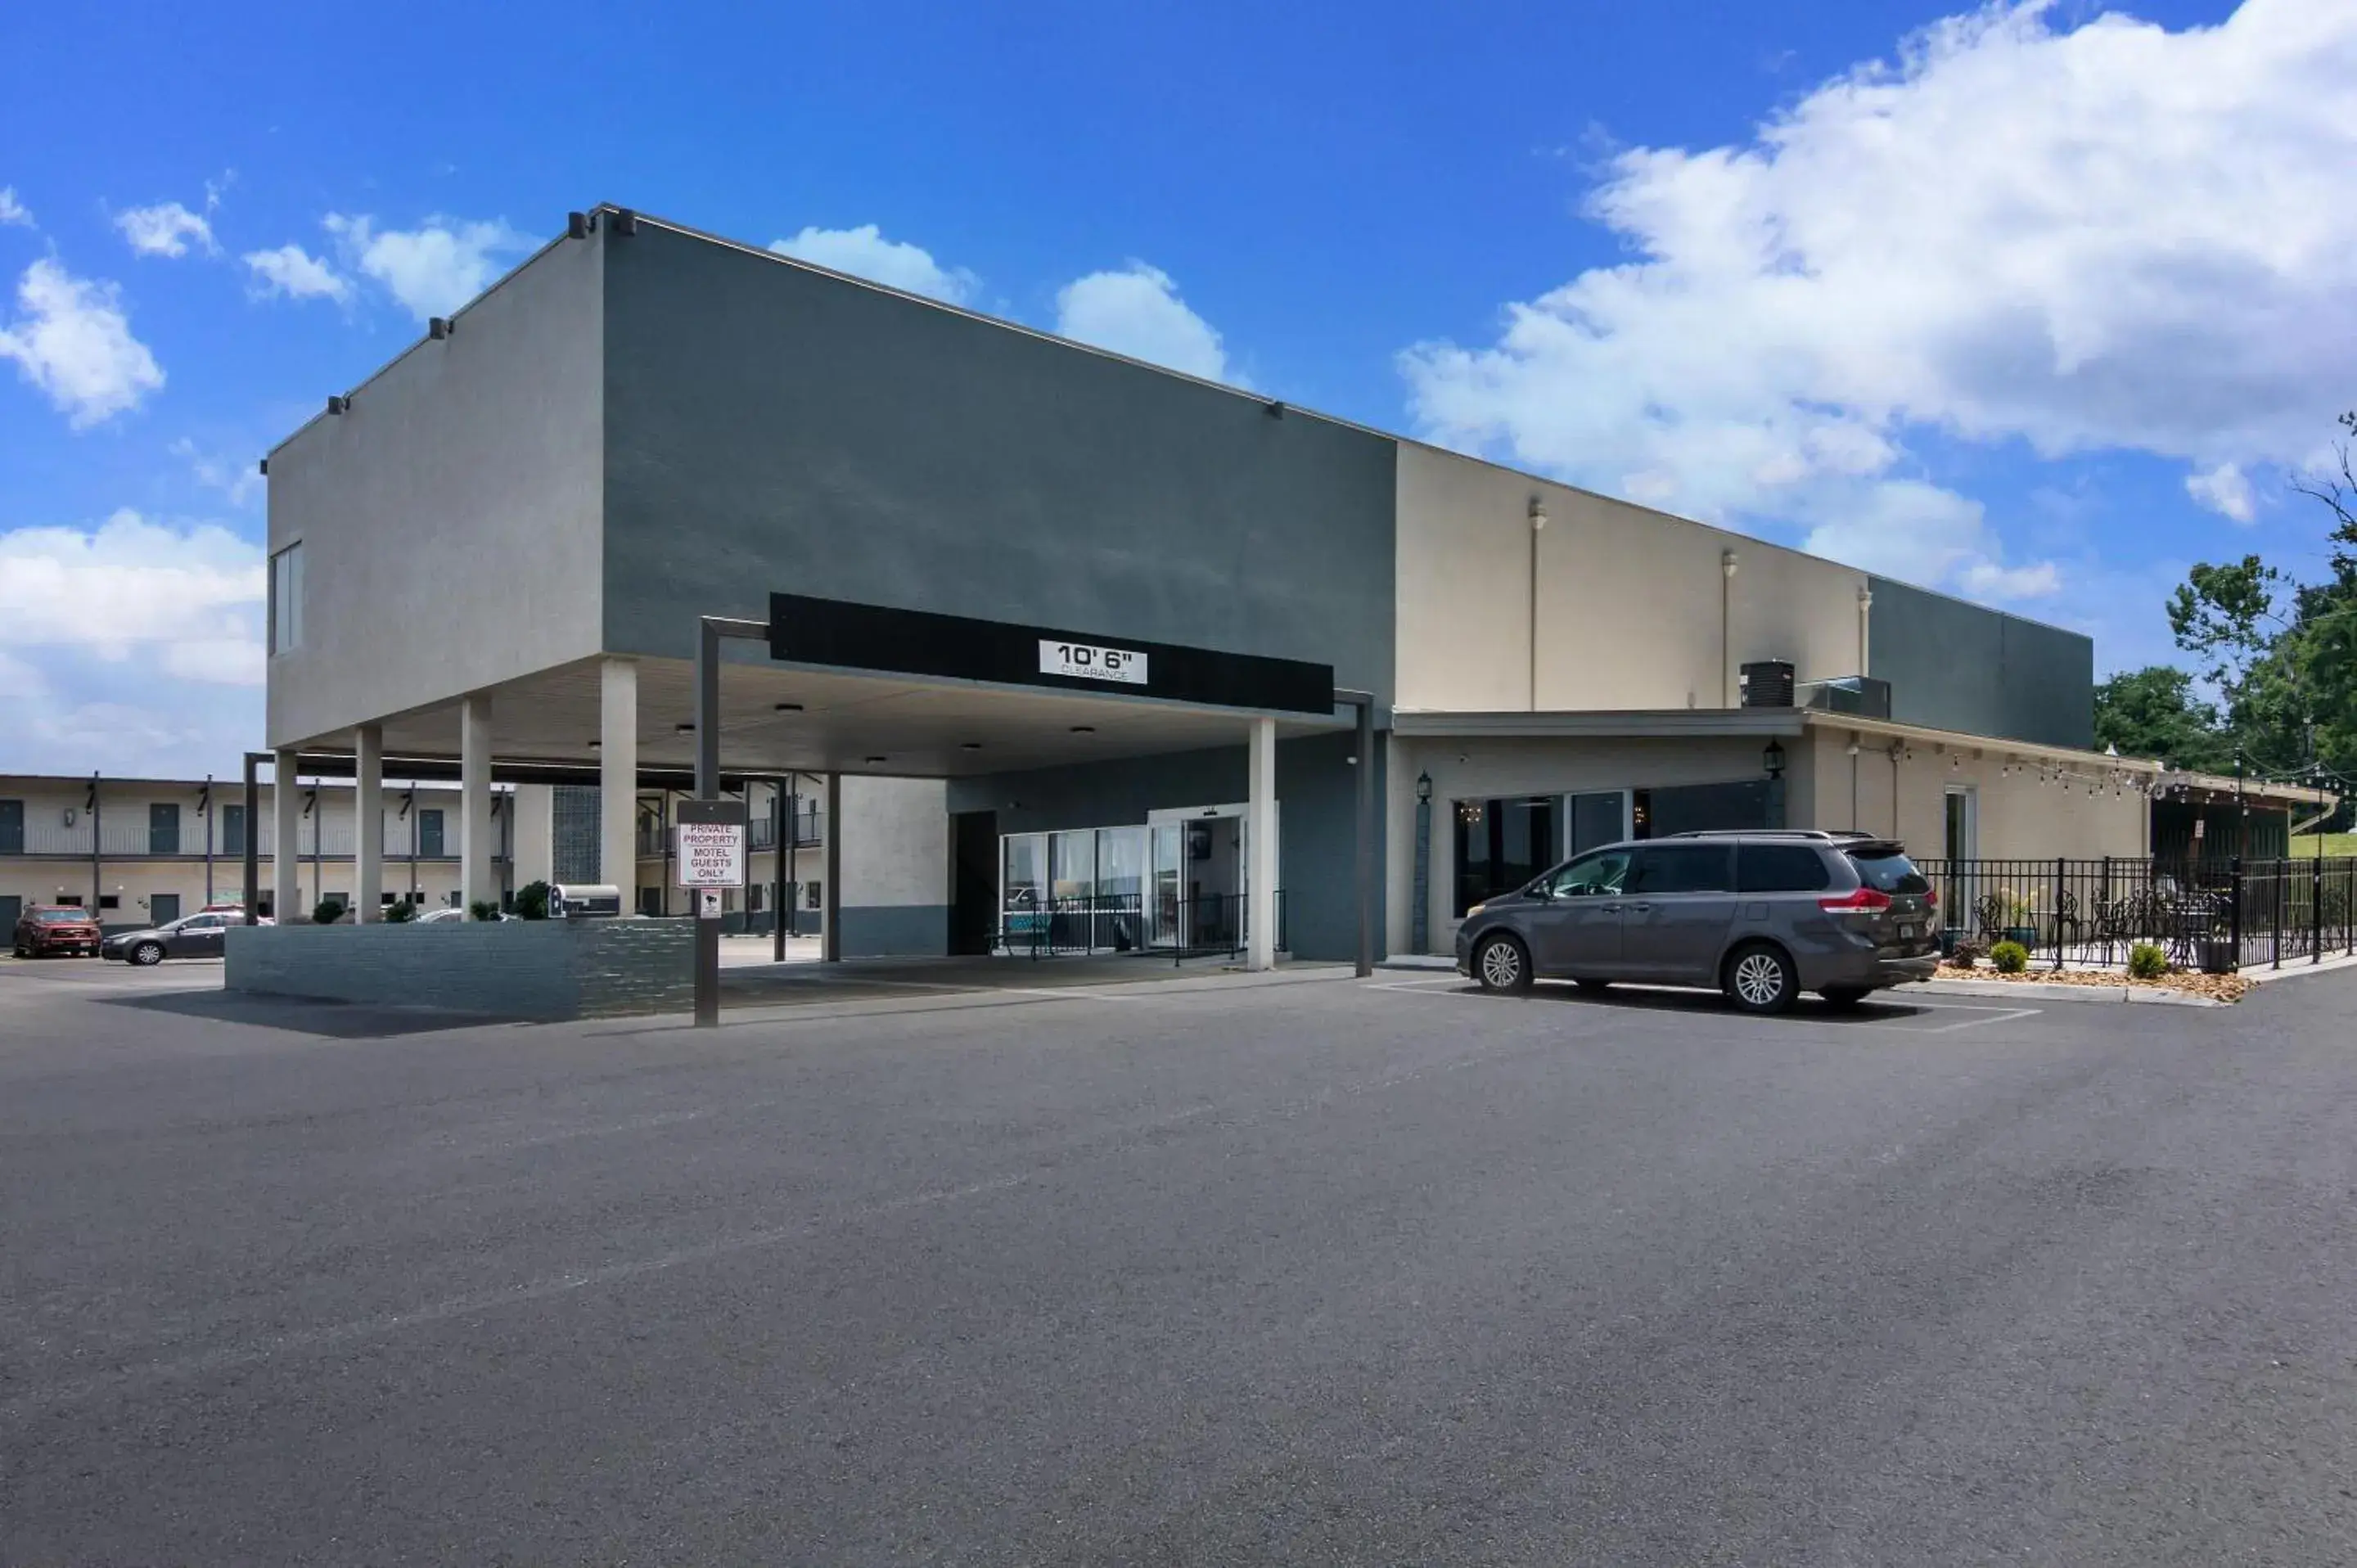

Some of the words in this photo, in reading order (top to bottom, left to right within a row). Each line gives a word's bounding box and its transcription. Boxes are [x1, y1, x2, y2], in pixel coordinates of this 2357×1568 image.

[1058, 645, 1097, 665] 10'
[1105, 651, 1132, 669] 6"
[1061, 664, 1129, 680] CLEARANCE
[691, 824, 732, 833] PRIVATE
[683, 836, 737, 844] PROPERTY
[694, 848, 730, 857] MOTEL
[691, 858, 732, 867] GUESTS
[698, 868, 724, 877] ONLY
